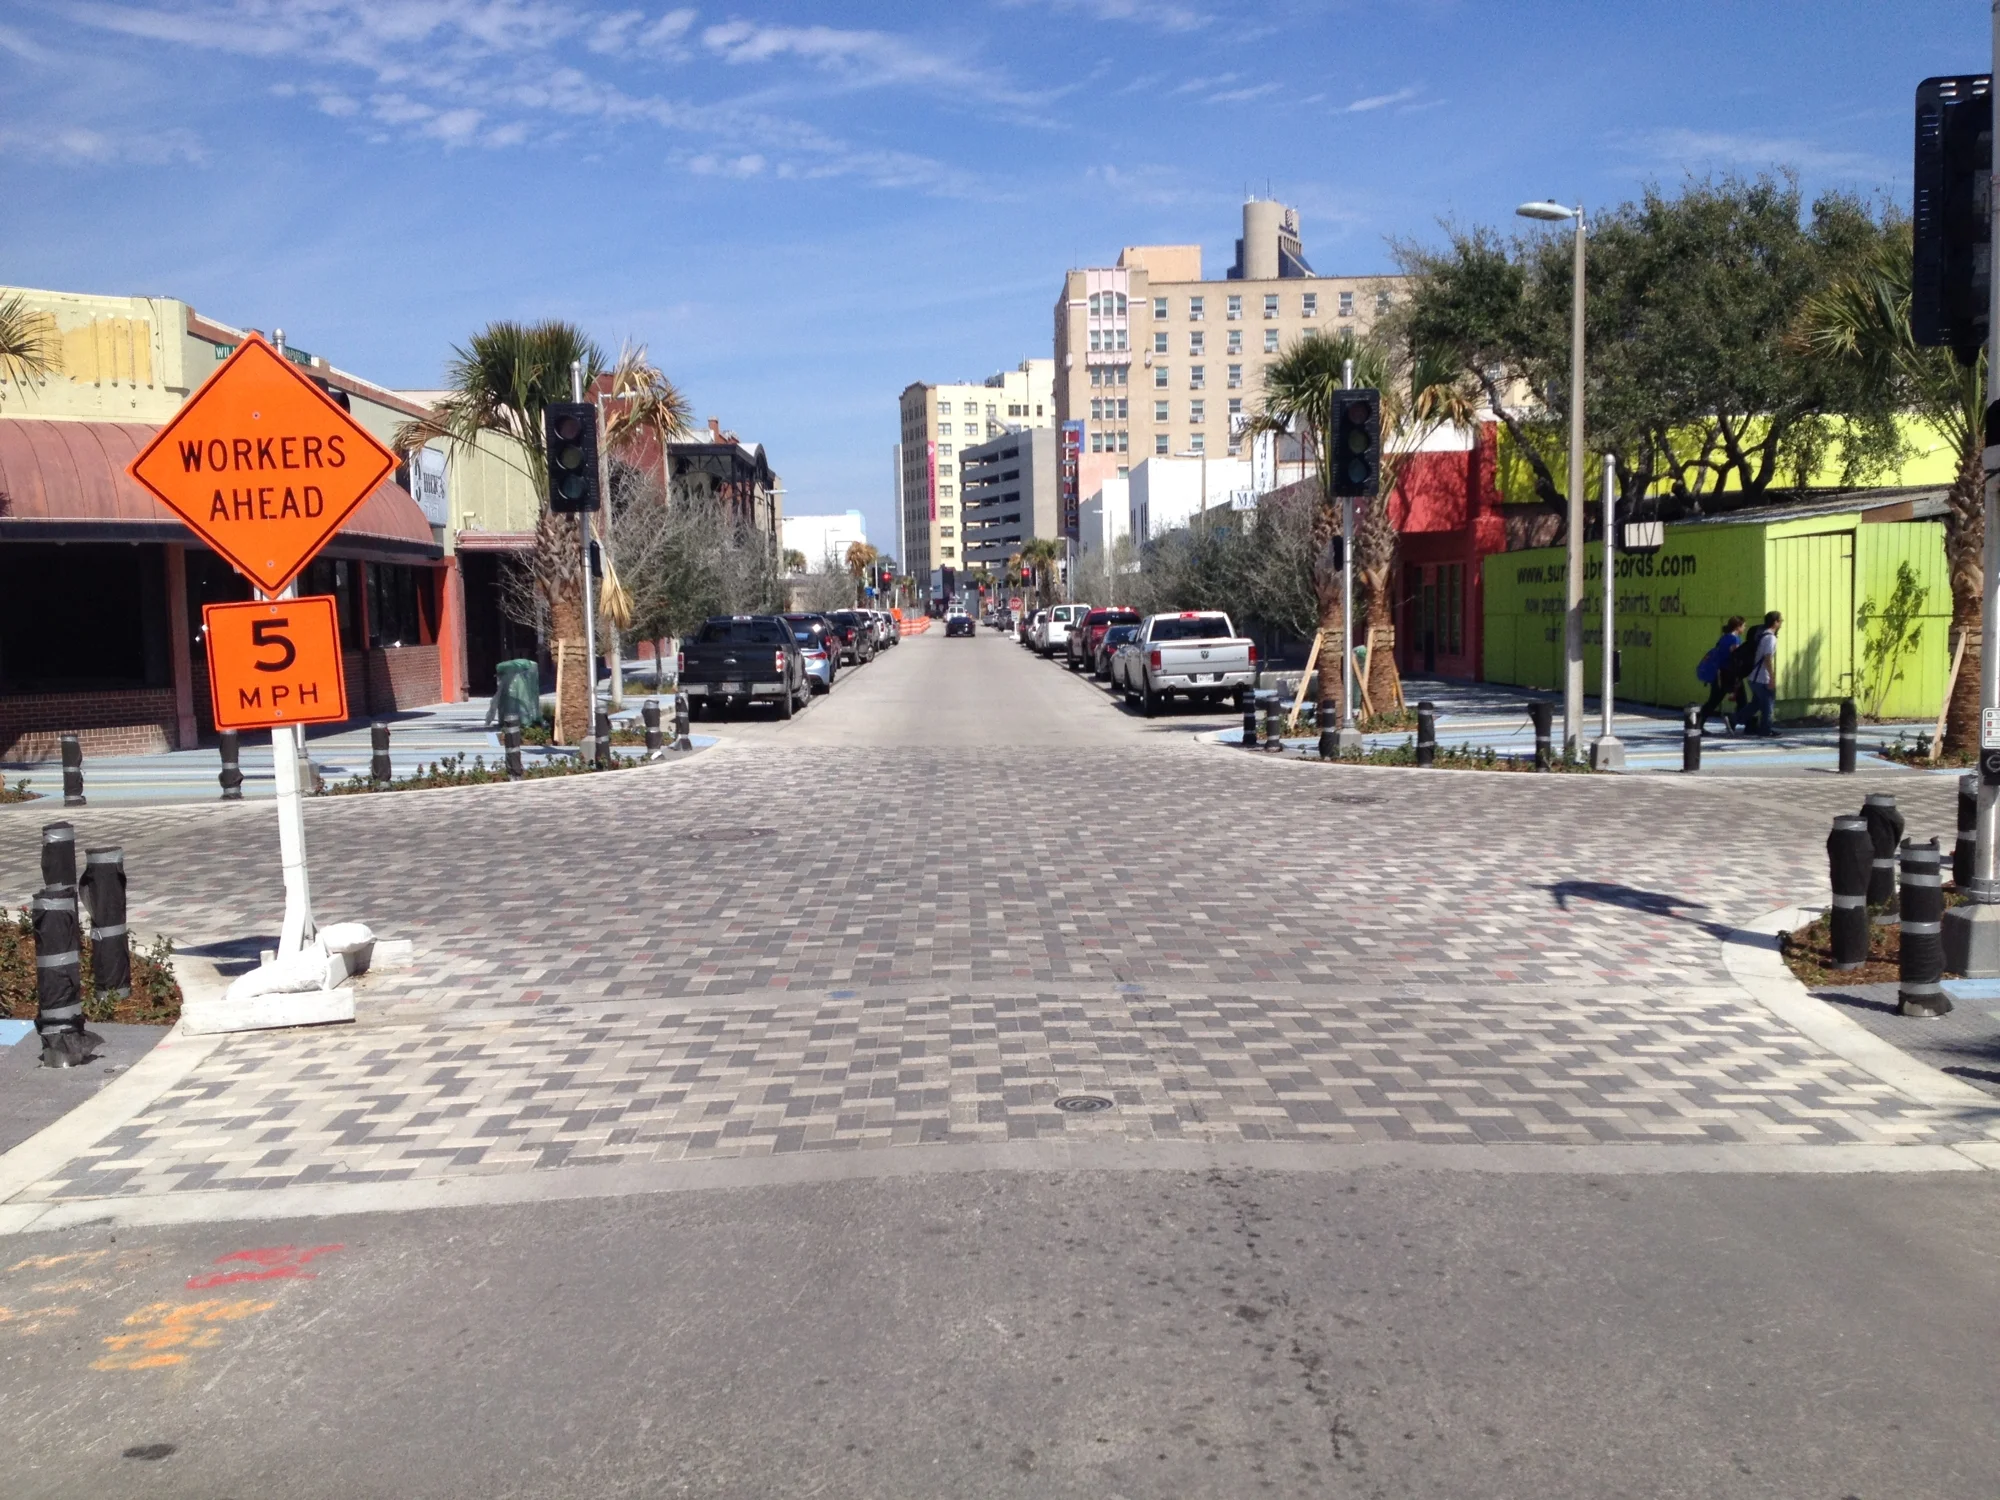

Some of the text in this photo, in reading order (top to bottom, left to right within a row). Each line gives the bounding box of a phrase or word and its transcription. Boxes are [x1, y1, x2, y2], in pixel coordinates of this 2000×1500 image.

[216, 346, 236, 358] WIL
[178, 435, 346, 472] WORKERS
[209, 486, 323, 521] AHEAD
[252, 618, 296, 672] 5
[239, 682, 319, 709] MPH
